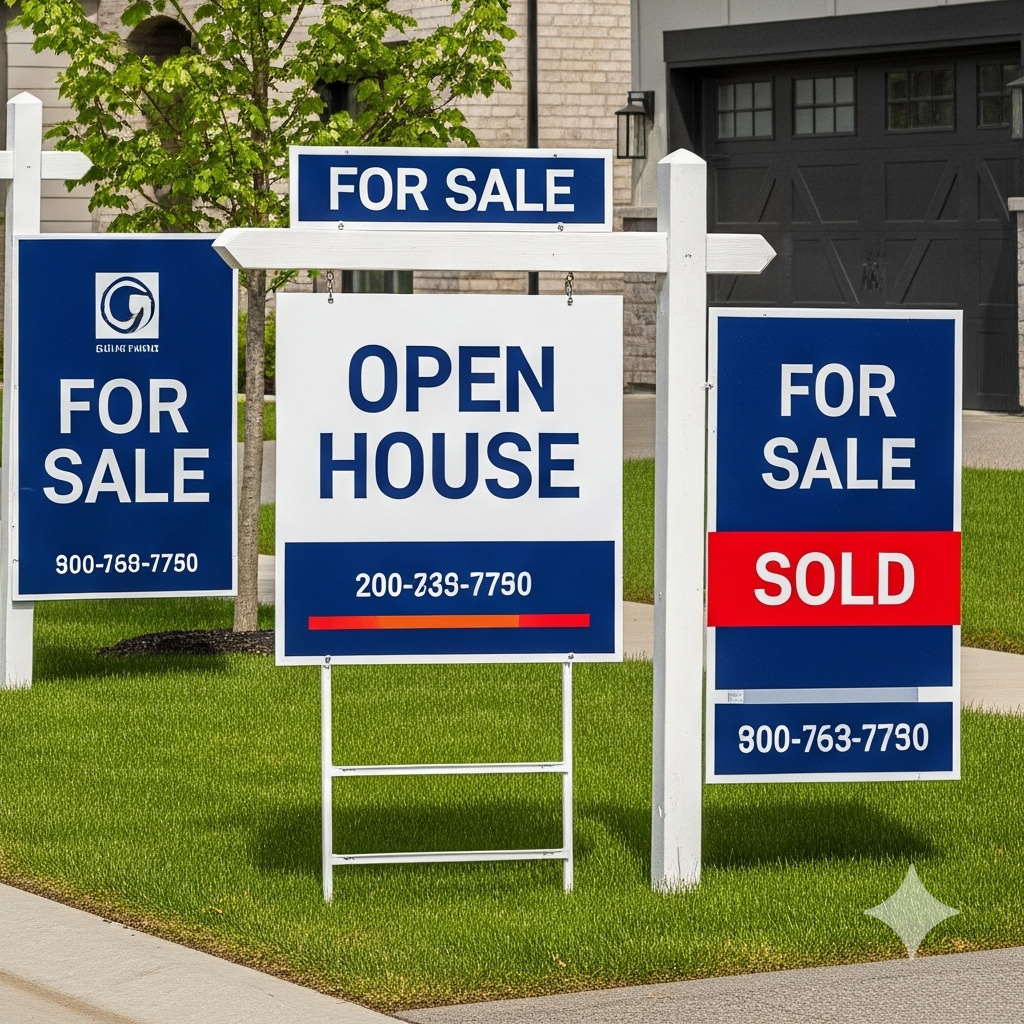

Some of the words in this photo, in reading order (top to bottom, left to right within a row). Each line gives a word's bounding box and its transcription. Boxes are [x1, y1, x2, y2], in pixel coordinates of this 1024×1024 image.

[330, 167, 429, 210] FOR
[446, 168, 574, 211] SALE
[349, 345, 554, 413] OPEN
[781, 363, 896, 417] FOR
[60, 379, 188, 434] FOR
[43, 449, 209, 504] SALE
[320, 432, 579, 499] HOUSE
[762, 437, 915, 489] SALE
[754, 552, 914, 605] SOLD
